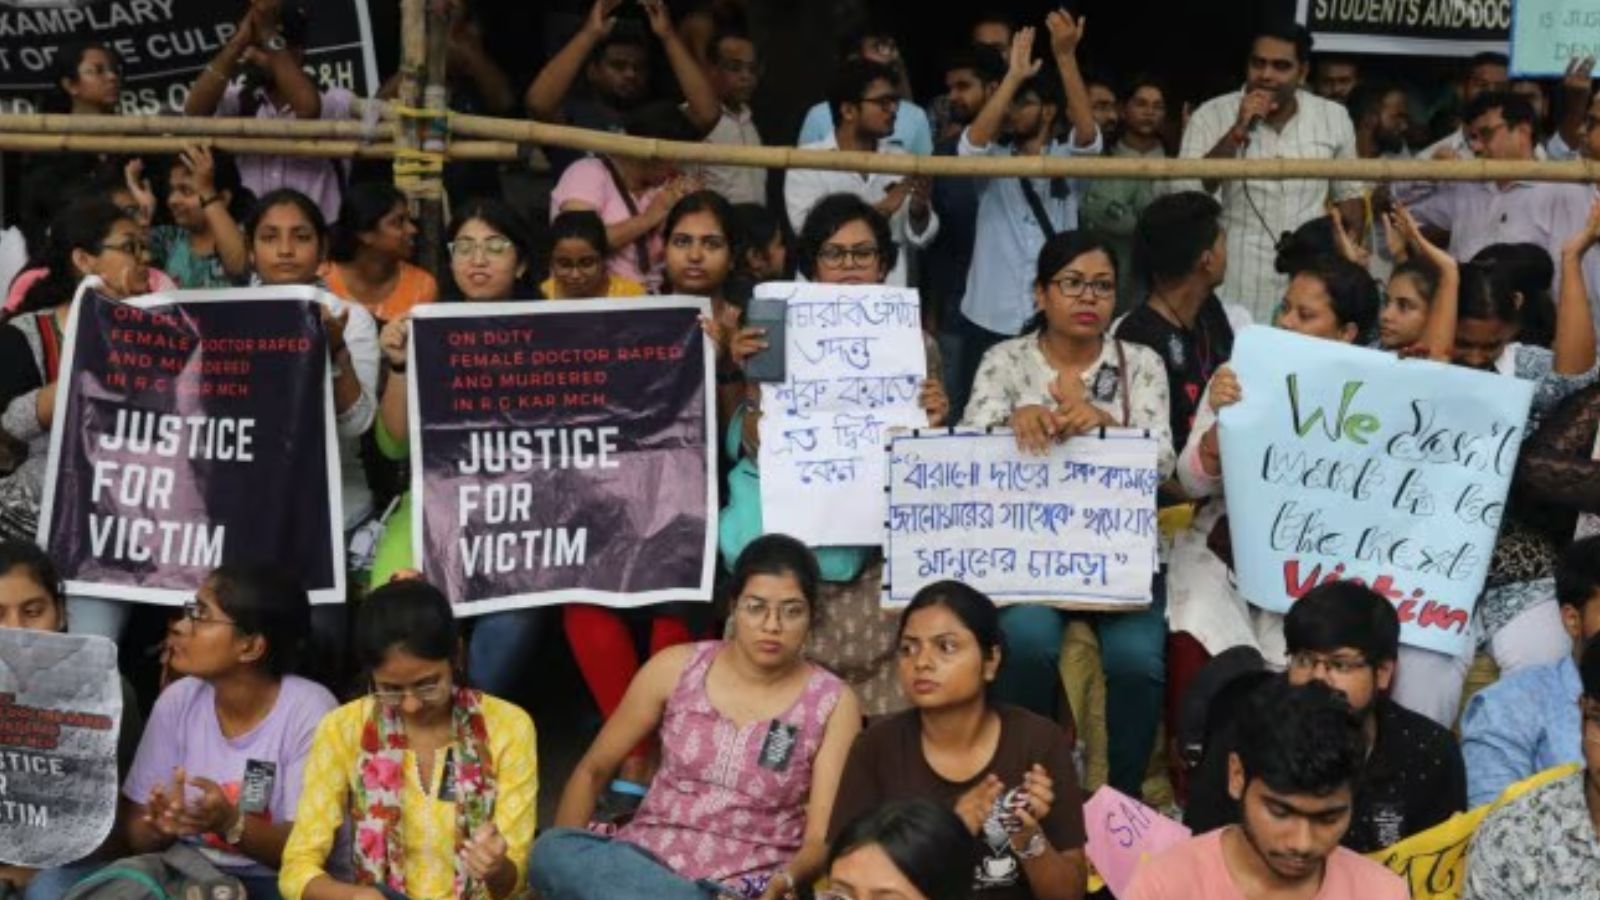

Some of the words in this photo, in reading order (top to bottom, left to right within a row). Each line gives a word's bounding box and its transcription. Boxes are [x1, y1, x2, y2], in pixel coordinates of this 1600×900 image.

[1315, 0, 1419, 25] STUDENTS
[1422, 0, 1467, 28] AND
[1471, 0, 1510, 28] DOC
[303, 60, 354, 89] &H
[114, 305, 143, 322] ON
[110, 328, 191, 351] FEMALE
[201, 338, 253, 352] DOCTOR
[258, 337, 312, 352] RAPED
[448, 331, 476, 346] ON
[483, 329, 534, 345] DUTY
[794, 336, 880, 370] তদন্ত
[108, 350, 151, 369] AND
[450, 351, 525, 368] FEMALE
[530, 348, 610, 365] DOCTOR
[617, 345, 684, 362] RAPED
[106, 373, 127, 388] IN
[215, 382, 249, 397] MCH
[451, 373, 493, 389] AND
[499, 370, 609, 387] MURDERED
[774, 374, 830, 419] শুরু
[836, 373, 922, 407] করতে
[453, 398, 474, 411] IN
[518, 393, 557, 409] KAR
[563, 392, 606, 407] MCH
[1286, 372, 1381, 445] We
[100, 408, 256, 462] JUSTICE
[458, 426, 620, 474] JUSTICE
[1386, 398, 1518, 477] don't
[91, 460, 175, 510] FOR
[1261, 444, 1387, 501] want
[1453, 482, 1506, 528] be
[458, 482, 533, 527] FOR
[88, 512, 226, 568] VICTIM
[458, 527, 588, 578] VICTIM
[1269, 500, 1346, 557] the
[1354, 525, 1482, 582] next
[913, 547, 1016, 580] মানুষের
